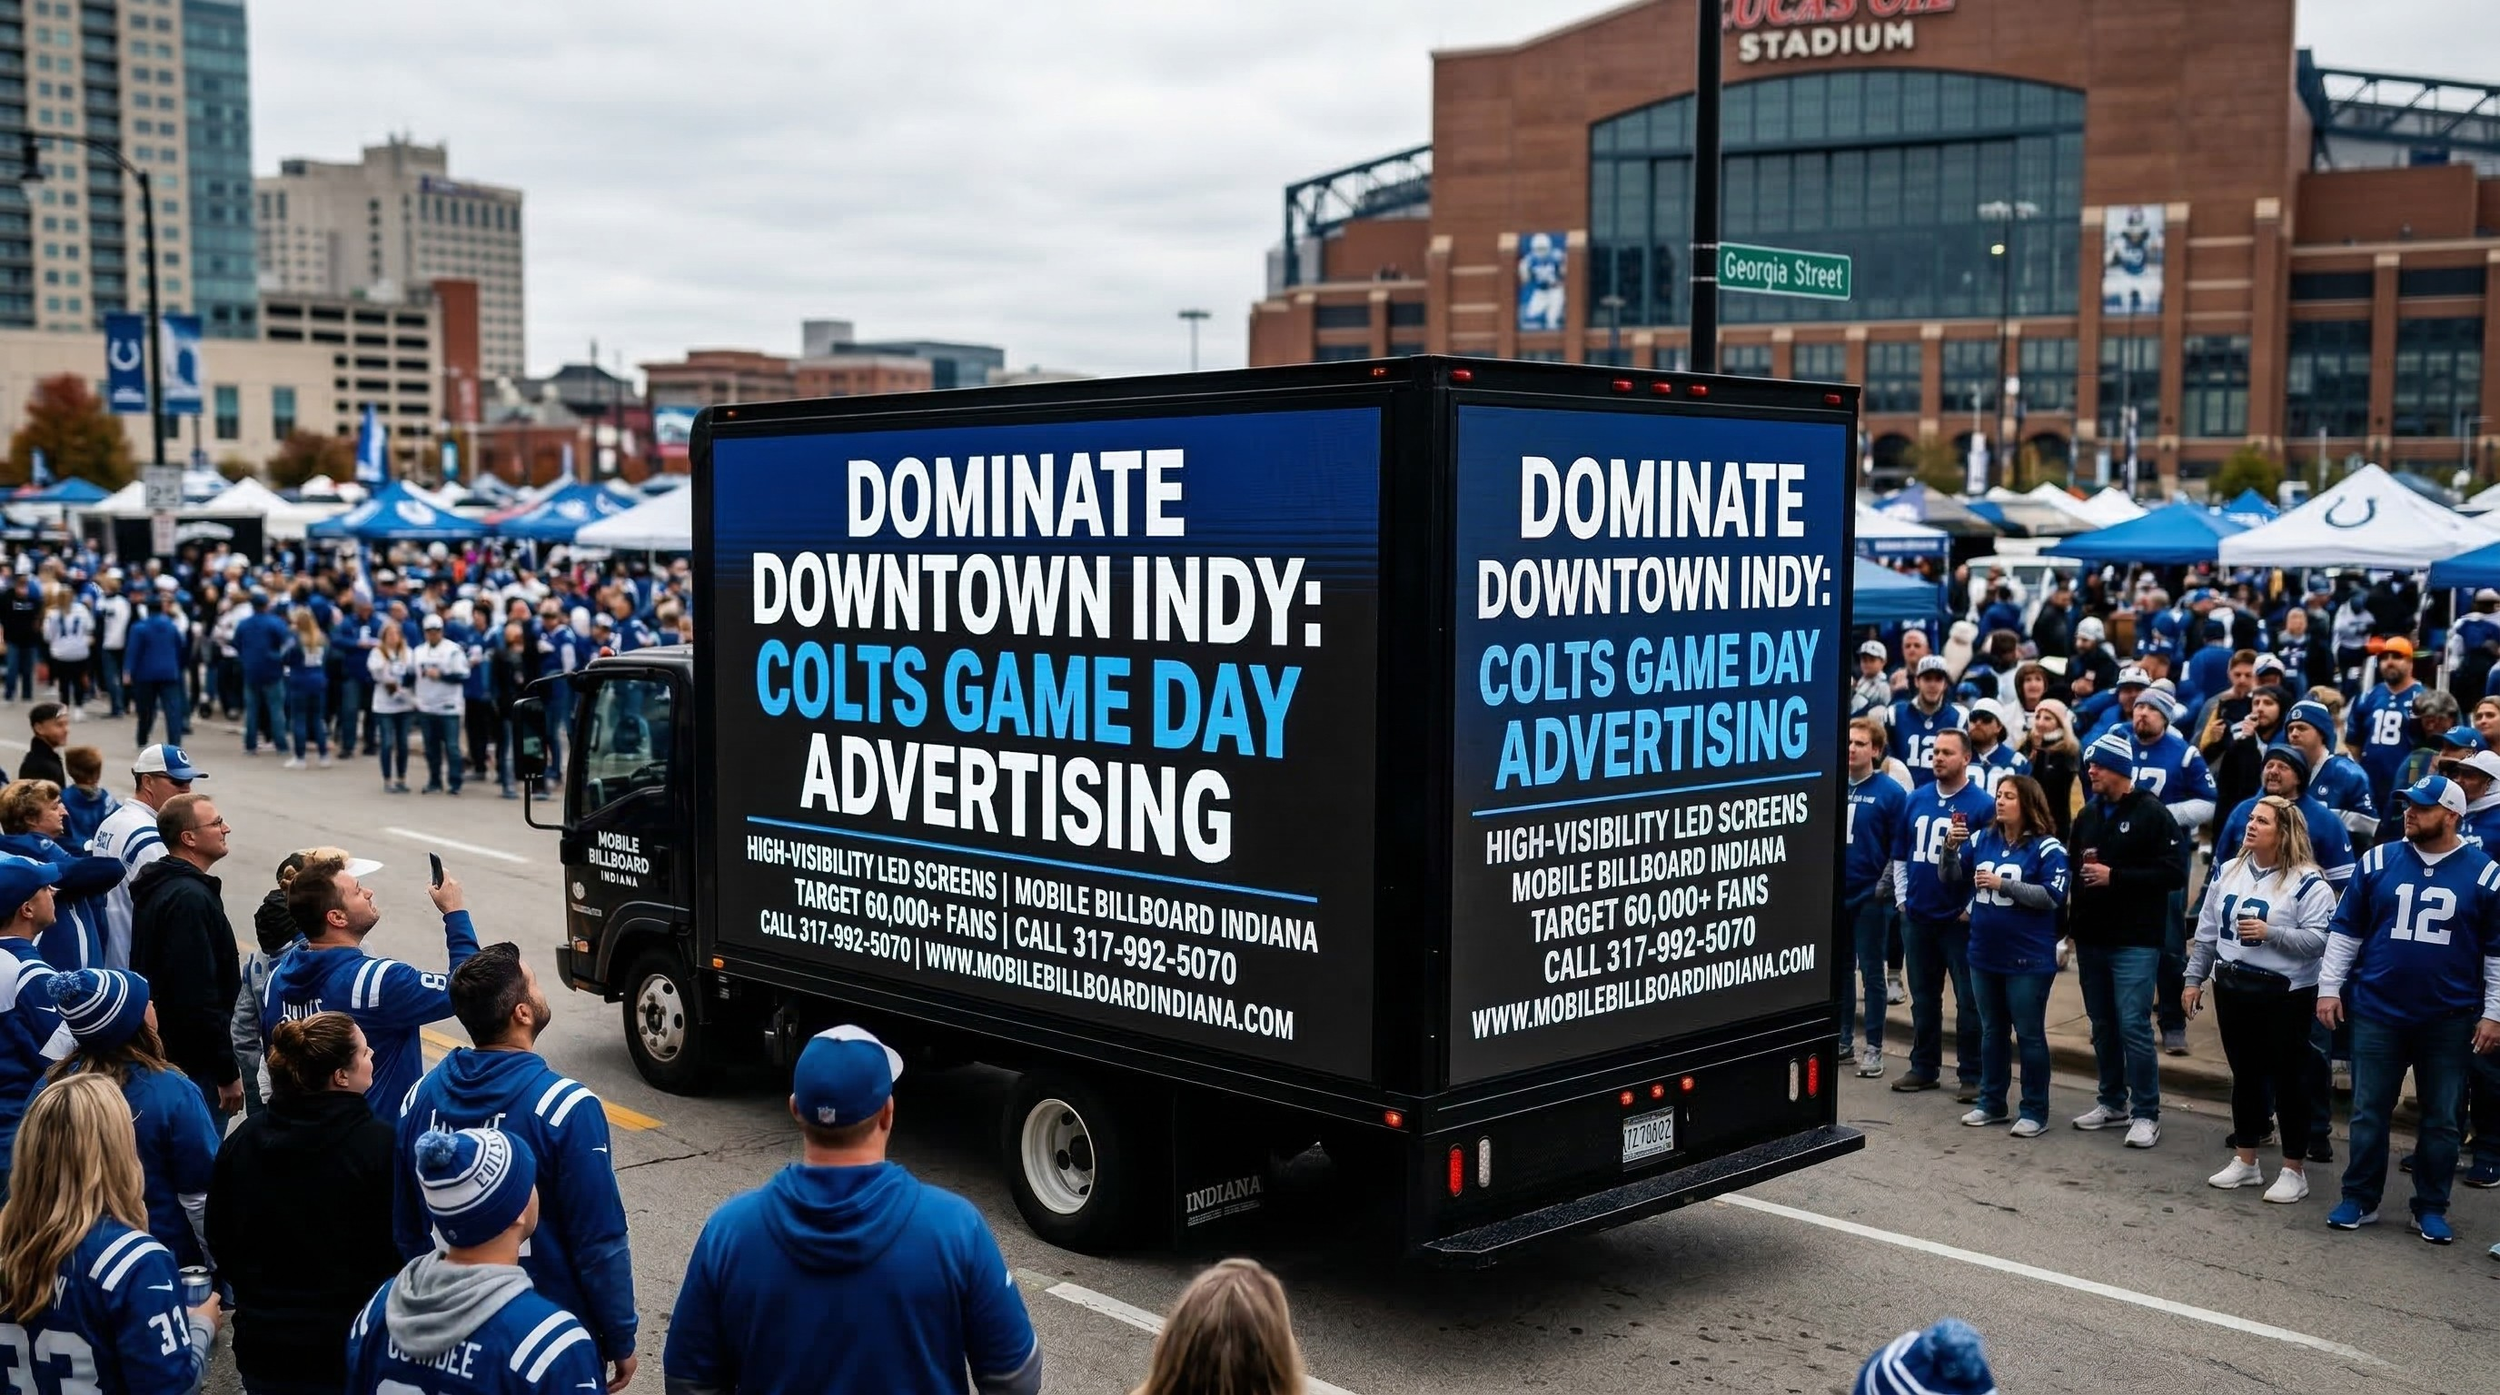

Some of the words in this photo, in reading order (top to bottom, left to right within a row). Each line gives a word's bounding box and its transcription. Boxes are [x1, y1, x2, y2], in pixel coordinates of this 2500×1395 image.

[1738, 19, 1914, 63] STADIUM
[1724, 251, 1788, 290] Georgia
[1794, 259, 1843, 289] Street
[848, 448, 1185, 539] DOMINATE
[1520, 455, 1805, 540] DOMINATE
[752, 551, 1111, 639] DOWNTOWN
[1132, 556, 1322, 647] INDY:
[1477, 555, 1730, 620] DOWNTOWN
[1740, 554, 1831, 610] INDY:
[756, 639, 928, 727] COLTS
[943, 648, 1132, 745] GAME
[1152, 658, 1302, 759] DAY
[1479, 639, 1615, 707] COLTS
[1626, 632, 1740, 695] GAME
[1750, 628, 1821, 687] DAY
[1494, 695, 1808, 791] ADVERTISING
[2371, 708, 2403, 745] 18
[799, 732, 1232, 864] ADVERTISING
[1485, 809, 1670, 865] HIGH-VISIBILITY
[1674, 804, 1714, 840] LED
[1717, 791, 1808, 834] SCREENS
[588, 848, 650, 875] BILLBOARD
[598, 830, 640, 854] MOBILE
[1511, 861, 1593, 903] MOBILE
[1598, 846, 1706, 890] BILLBOARD
[1710, 834, 1787, 873] INDIANA
[600, 870, 638, 888] INDIANA
[746, 835, 875, 880] HIGH-VISIBILITY
[877, 855, 910, 885] LED
[913, 860, 997, 900] SCREENS
[1014, 875, 1090, 916] MOBILE
[1094, 888, 1215, 936] BILLBOARD
[1221, 908, 1319, 953] INDIANA
[1531, 897, 1619, 943] TARGET
[1624, 885, 1711, 928] 60,000+
[1716, 873, 1769, 911] FANS
[2391, 883, 2457, 945] 12
[794, 877, 861, 917] TARGET
[865, 890, 942, 929] 60,000+
[946, 903, 997, 942] FANS
[1015, 916, 1067, 955] CALL
[1072, 926, 1237, 986] 317-992-5070
[1544, 940, 1602, 984] CALL
[1606, 915, 1756, 973] 317-992-5070
[760, 909, 797, 940] CALL
[799, 916, 911, 963] 317-992-5070
[925, 940, 1294, 1041] WWW.MOBILEBILLBOARDINDIANA.COM
[1471, 944, 1815, 1039] WWW.MOBILEBILLBOARDINDIANA.COM
[1186, 1175, 1261, 1214] INDIANA
